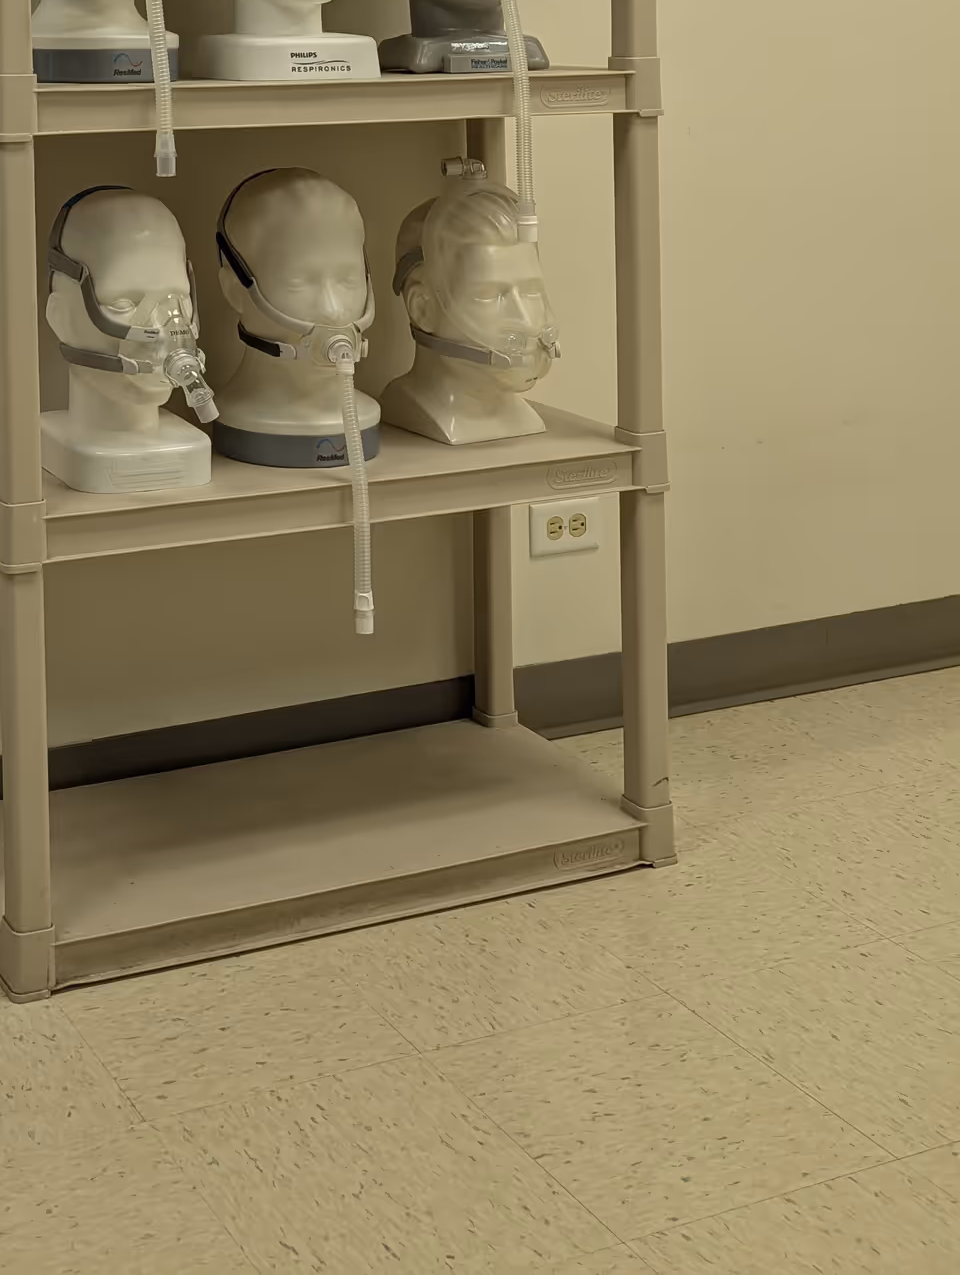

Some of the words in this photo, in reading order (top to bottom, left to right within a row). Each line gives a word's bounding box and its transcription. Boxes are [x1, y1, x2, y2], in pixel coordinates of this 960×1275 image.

[290, 51, 318, 59] PHILIPS
[113, 68, 142, 76] ResMed
[291, 65, 352, 73] RESPIRONICS
[316, 453, 345, 462] ResMed
